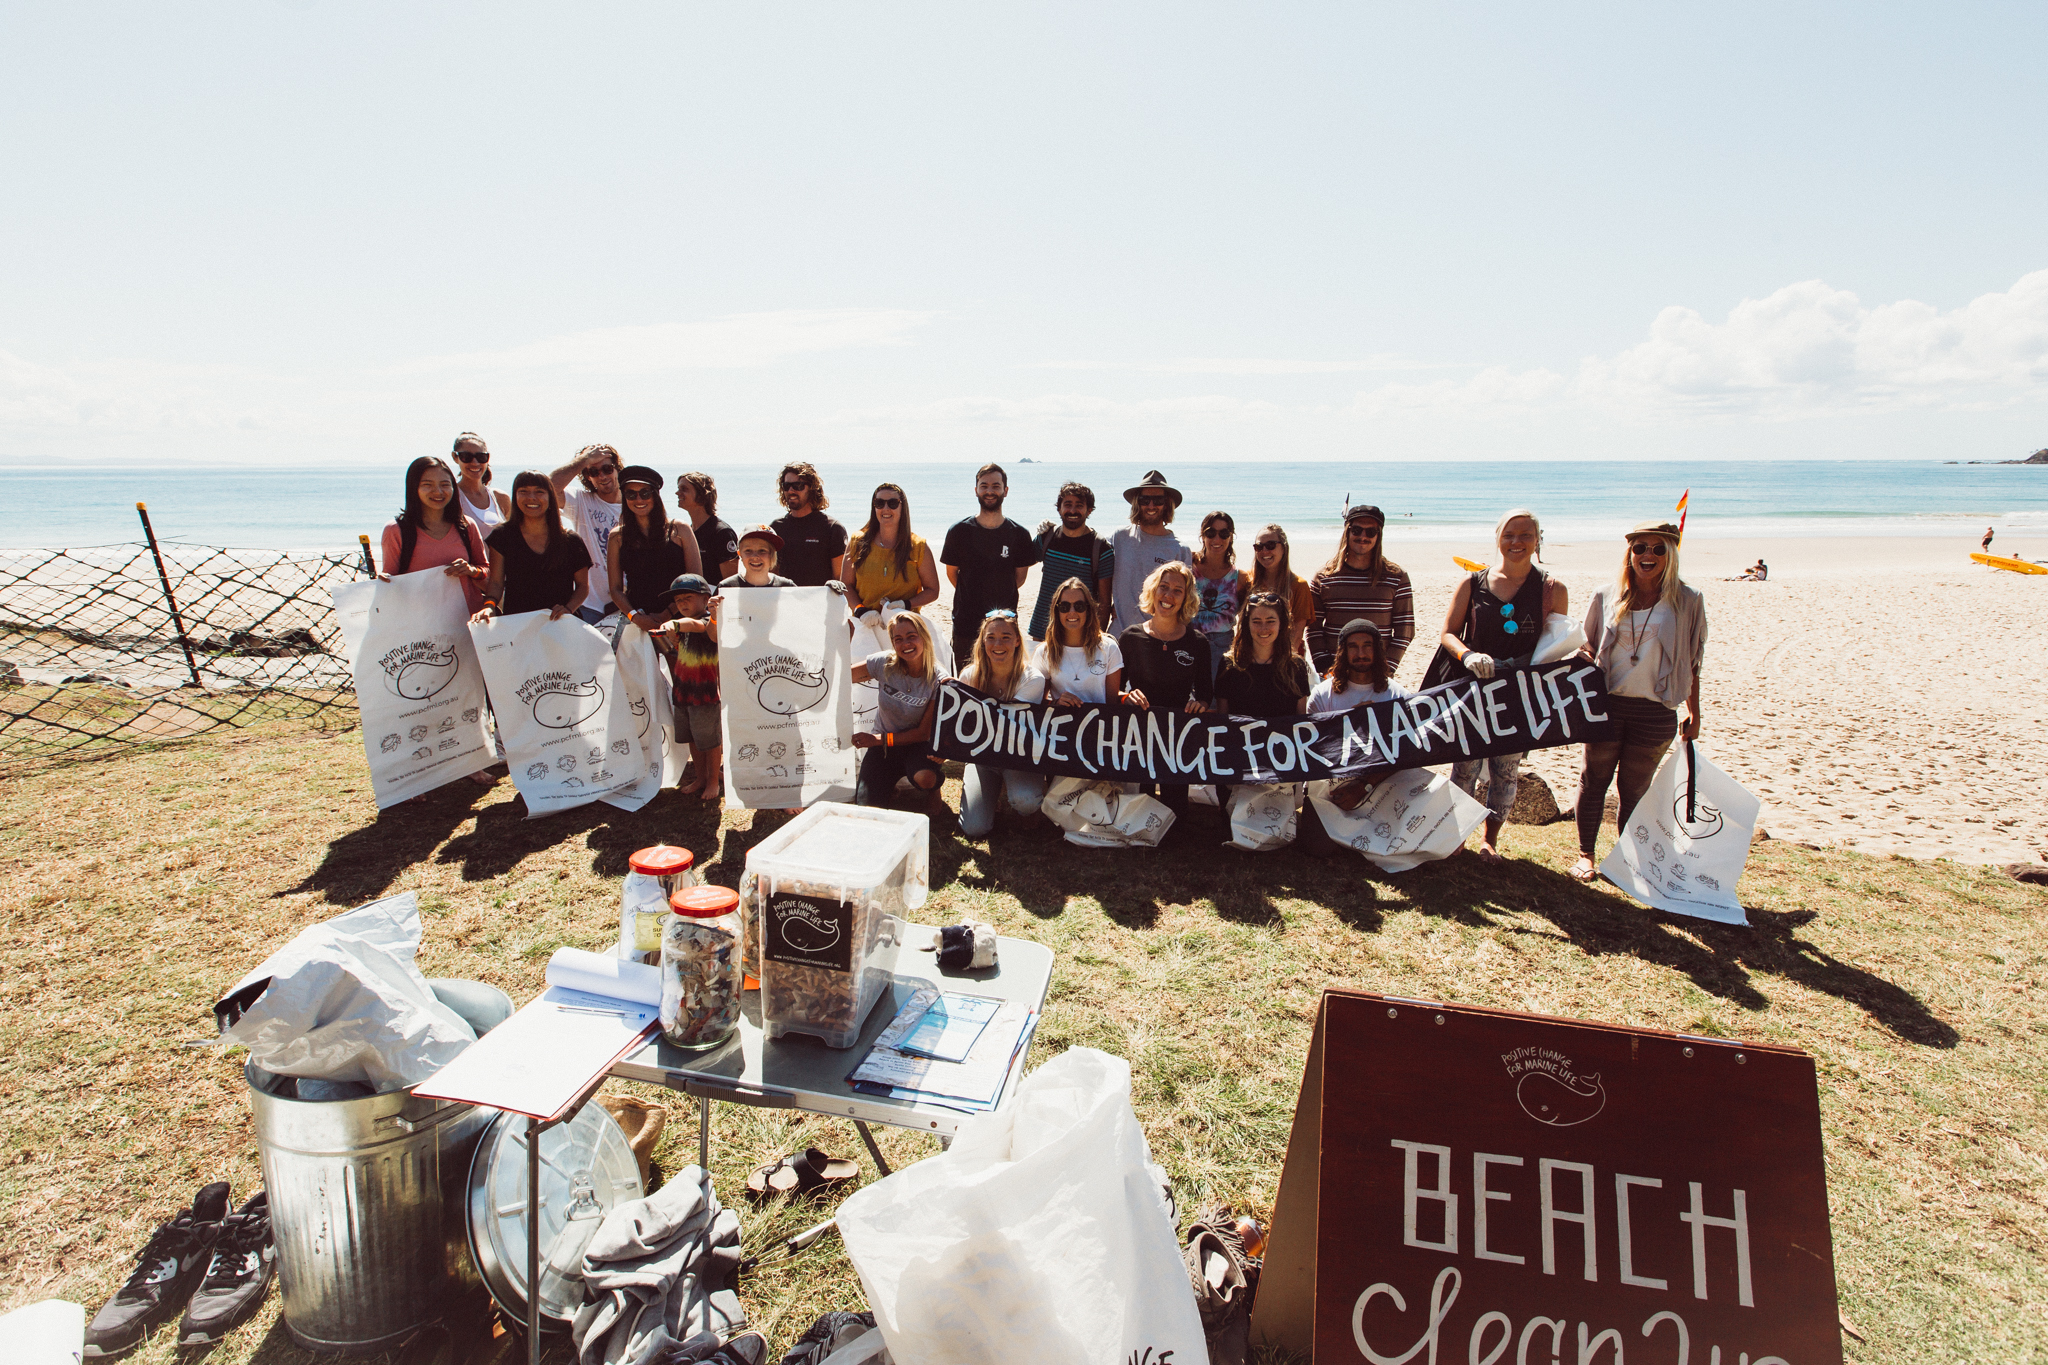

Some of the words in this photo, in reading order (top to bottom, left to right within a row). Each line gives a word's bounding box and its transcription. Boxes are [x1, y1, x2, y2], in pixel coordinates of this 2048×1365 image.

[378, 644, 409, 668] POSITIVE
[410, 641, 435, 652] CHANGE
[385, 663, 401, 676] FOR
[400, 652, 426, 666] MARINE
[426, 652, 440, 663] LIFE
[743, 656, 773, 675] POSITIVE
[774, 655, 802, 669] CHANGE
[515, 674, 541, 697] POSITIVE
[543, 671, 572, 682] CHANGE
[748, 671, 763, 685] FOR
[763, 665, 790, 677] MARINE
[791, 669, 807, 682] LIFE
[522, 691, 536, 706] FOR
[535, 681, 561, 696] MARINE
[563, 682, 579, 693] LIFE
[398, 696, 459, 720] www.pcfml.org.au
[757, 720, 820, 731] www.pcfml.org.au
[933, 685, 1074, 765] POSITIVE
[1075, 708, 1234, 780] CHANGE
[1239, 720, 1334, 780] FOR
[1340, 678, 1518, 765] MARINE
[1516, 664, 1608, 741] LIFE
[541, 726, 605, 748] www.pcfml.org.au
[773, 900, 797, 912] POSITIVE
[798, 900, 820, 916] CHANGE
[776, 911, 788, 921] FOR
[788, 908, 810, 919] MARINE
[810, 915, 823, 927] LIFE
[1501, 1046, 1537, 1066] POSITIVE
[1538, 1047, 1572, 1069] CHANGE
[1506, 1062, 1524, 1078] FOR
[1525, 1058, 1559, 1074] MARINE
[1559, 1067, 1578, 1086] LIFE
[1391, 1139, 1755, 1308] BEACH
